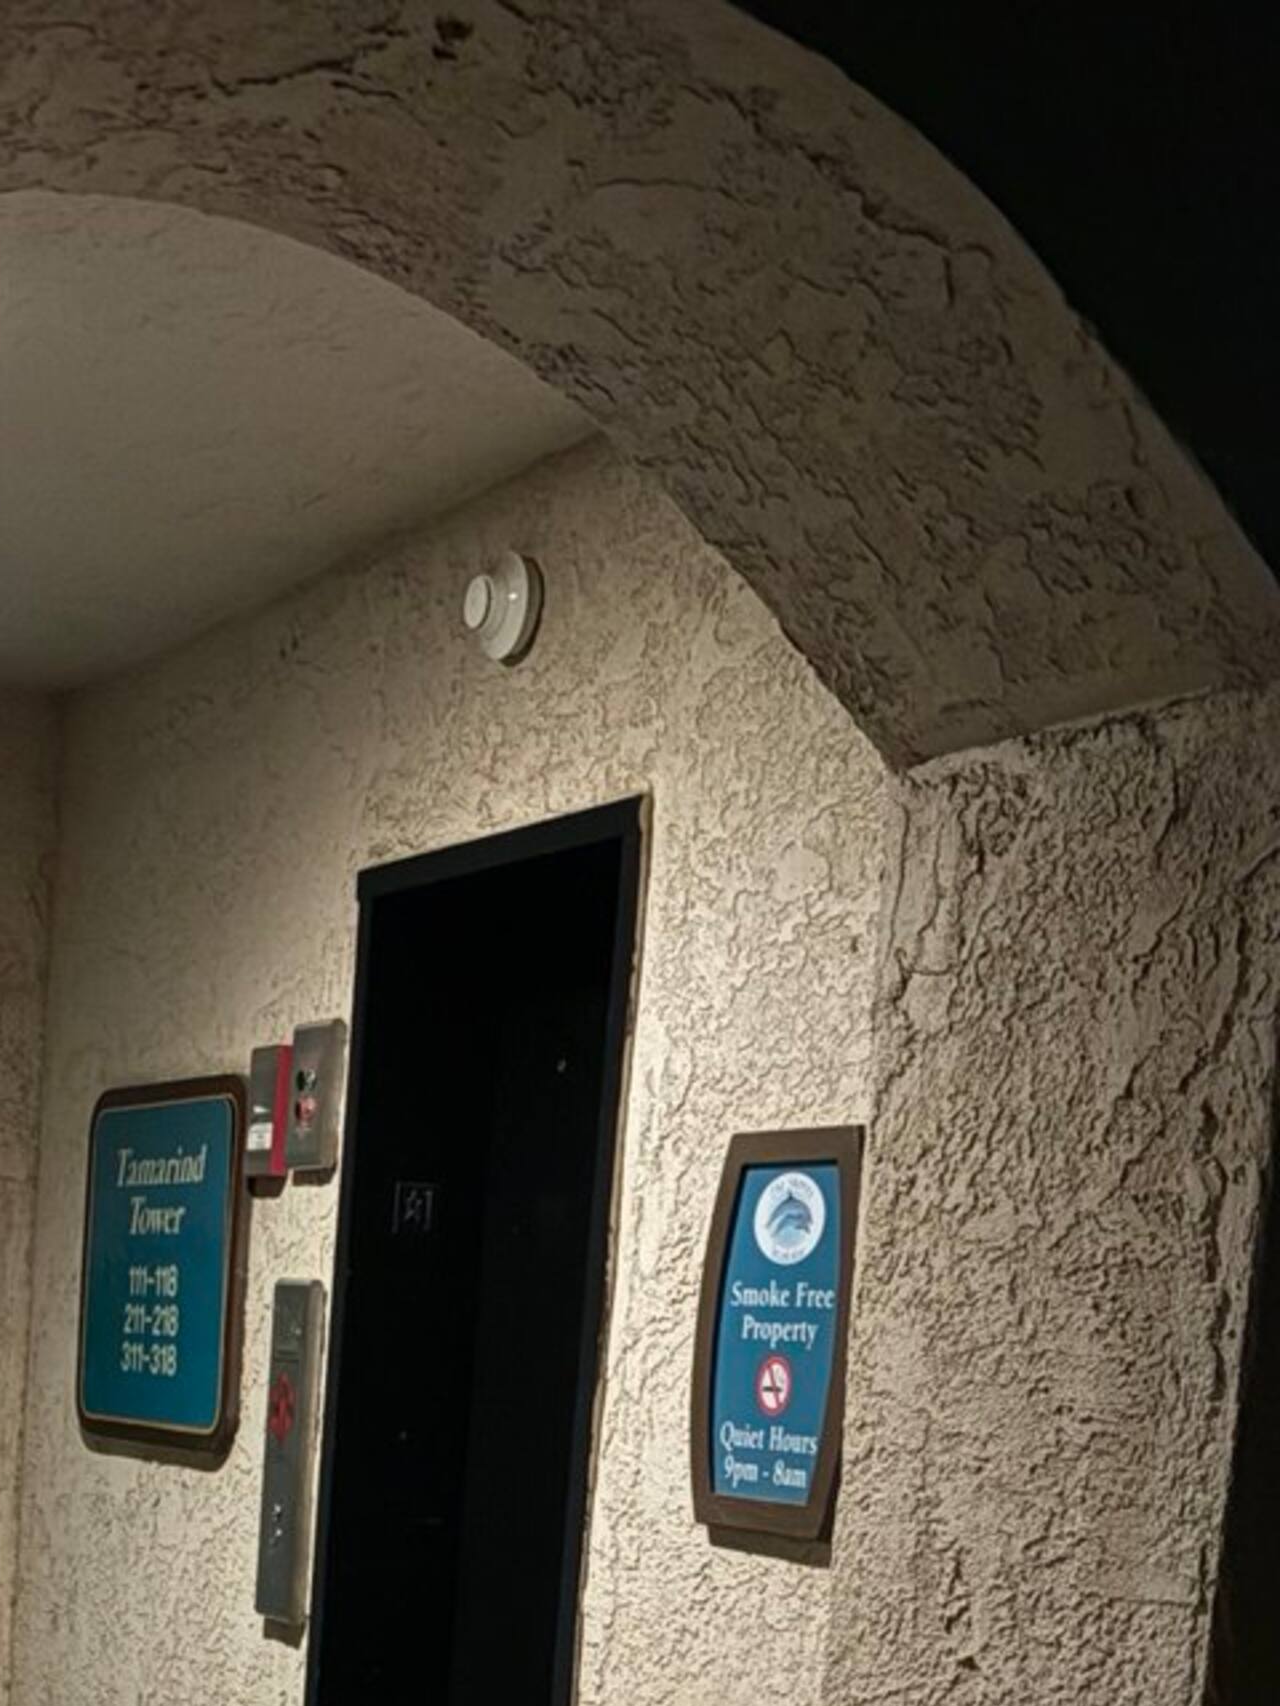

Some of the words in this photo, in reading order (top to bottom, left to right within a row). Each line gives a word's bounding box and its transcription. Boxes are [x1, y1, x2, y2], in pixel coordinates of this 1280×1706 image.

[117, 1143, 207, 1187] Tamarind
[129, 1196, 186, 1234] Tower
[128, 1264, 179, 1298] 111-118
[730, 1280, 791, 1308] Smoke
[795, 1281, 836, 1310] Free
[123, 1303, 180, 1337] 211-218
[741, 1314, 819, 1351] Property
[120, 1341, 178, 1377] 311-318
[720, 1421, 765, 1452] Quiet
[769, 1425, 818, 1456] Hours
[724, 1454, 759, 1489] 9pm
[772, 1459, 807, 1489] 8am
